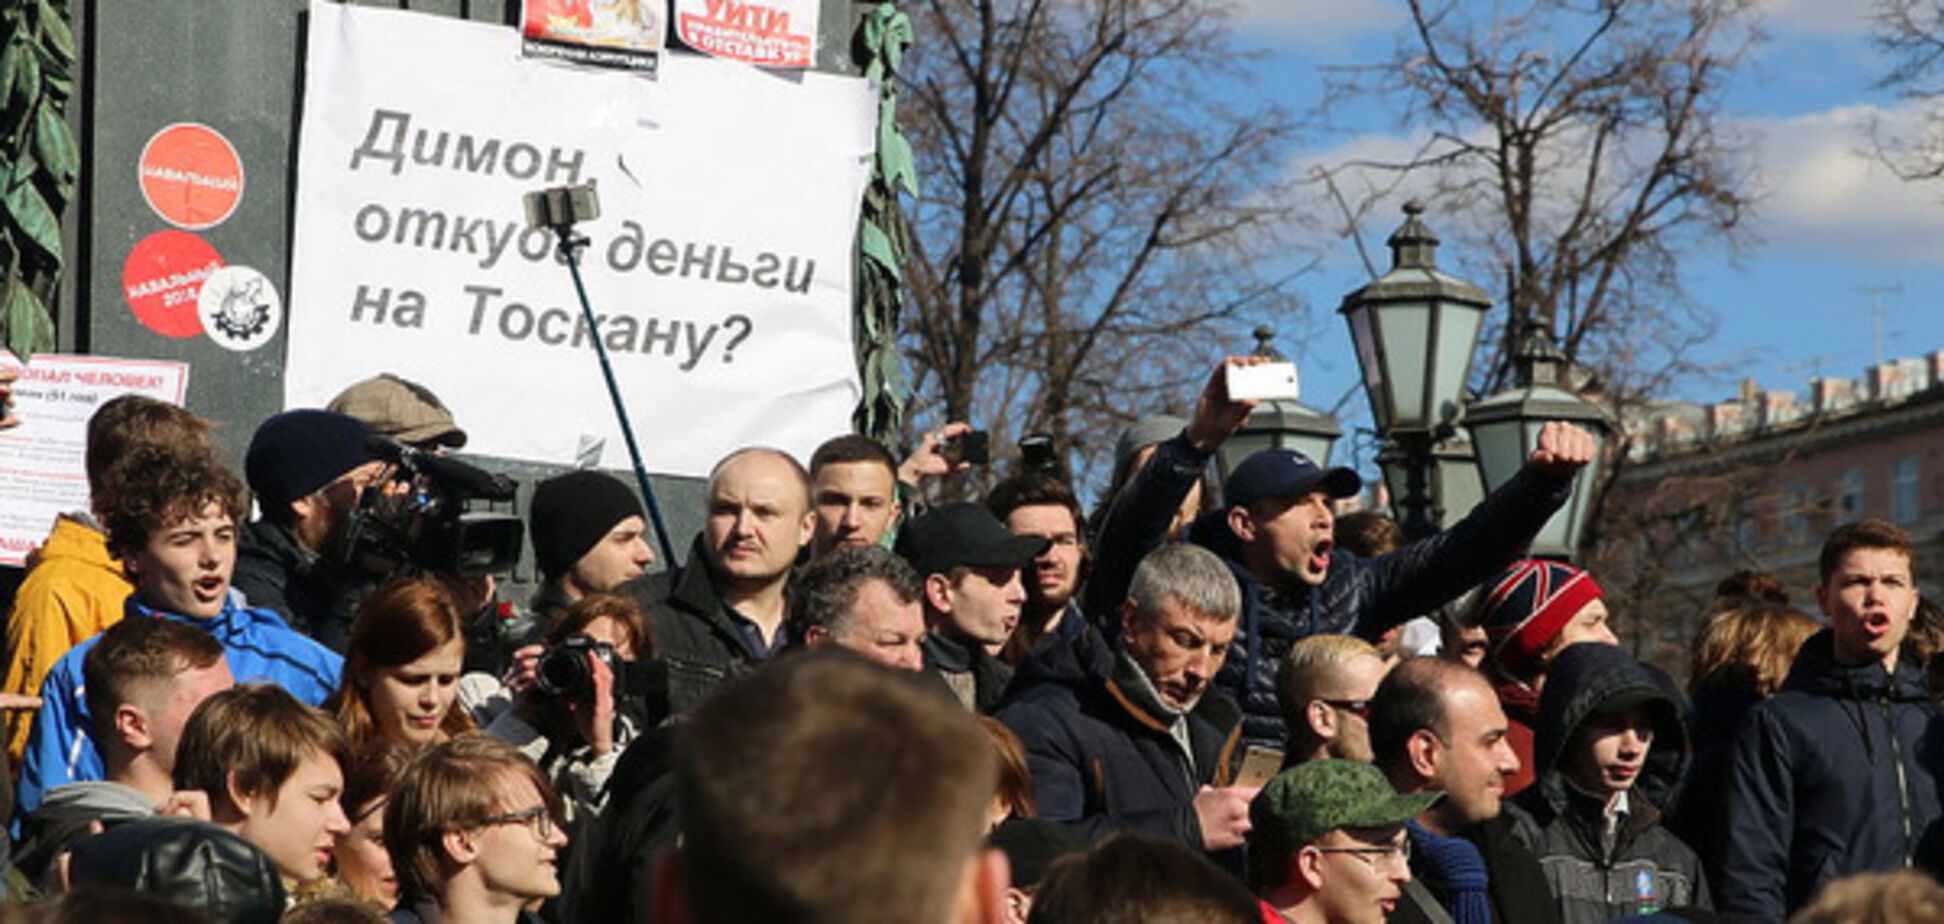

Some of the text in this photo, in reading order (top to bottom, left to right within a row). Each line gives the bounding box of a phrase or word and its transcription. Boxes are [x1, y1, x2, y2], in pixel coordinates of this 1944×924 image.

[349, 109, 597, 188] Димон,
[606, 221, 815, 294] деньги
[350, 283, 752, 372] на Тоскану?
